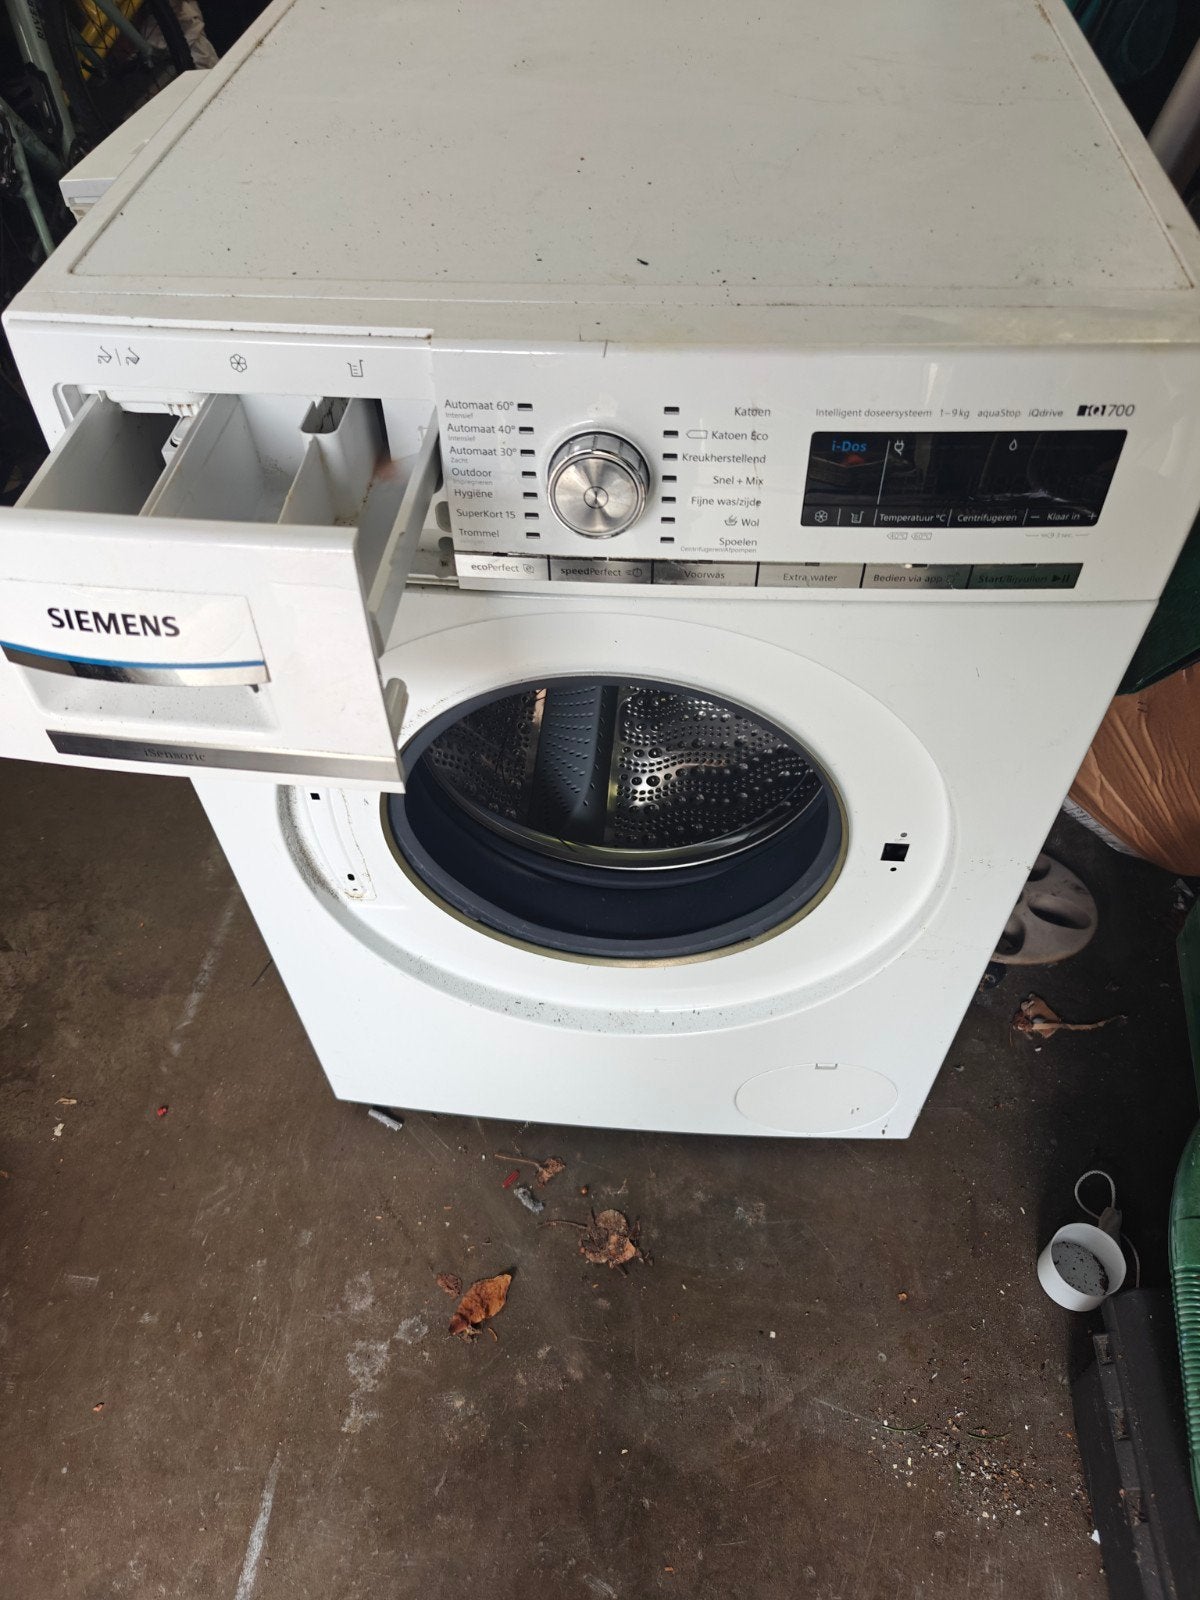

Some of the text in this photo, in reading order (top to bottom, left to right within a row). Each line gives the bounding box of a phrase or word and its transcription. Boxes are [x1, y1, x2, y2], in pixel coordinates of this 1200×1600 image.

[445, 399, 514, 411] Automaat 60°
[734, 406, 771, 417] Katoen
[816, 408, 862, 419] Intelligent
[863, 409, 932, 419] doseersysteem
[959, 409, 970, 419] kg
[977, 408, 1021, 419] aquaStop
[1028, 408, 1064, 418] iQdrive
[447, 423, 516, 434] Automaat 40°
[711, 431, 747, 441] Katoen
[831, 440, 867, 452] i-Dos
[449, 446, 517, 457] Automaat 30°
[682, 453, 766, 464] Kreukherstellend
[451, 468, 492, 477] Outdoor
[713, 476, 734, 485] Snel
[746, 477, 764, 486] Mix
[691, 496, 762, 508] Fijne was/zijde
[456, 509, 516, 519] SuperKort 15
[879, 514, 934, 524] Temperatuur
[957, 513, 1017, 524] Centrifugeren
[1047, 512, 1069, 520] Klaar
[1071, 512, 1080, 520] in
[741, 518, 760, 527] Wol
[459, 528, 499, 538] Trommel
[719, 537, 758, 547] Spoelen
[471, 563, 519, 573] ecoPerfect
[560, 567, 622, 577] speedPerfect
[684, 570, 725, 579] Voorwas
[783, 573, 838, 582] Extra water
[873, 574, 942, 584] Bedien via app
[47, 606, 181, 638] SIEMENS
[144, 747, 206, 761] iSensoric
